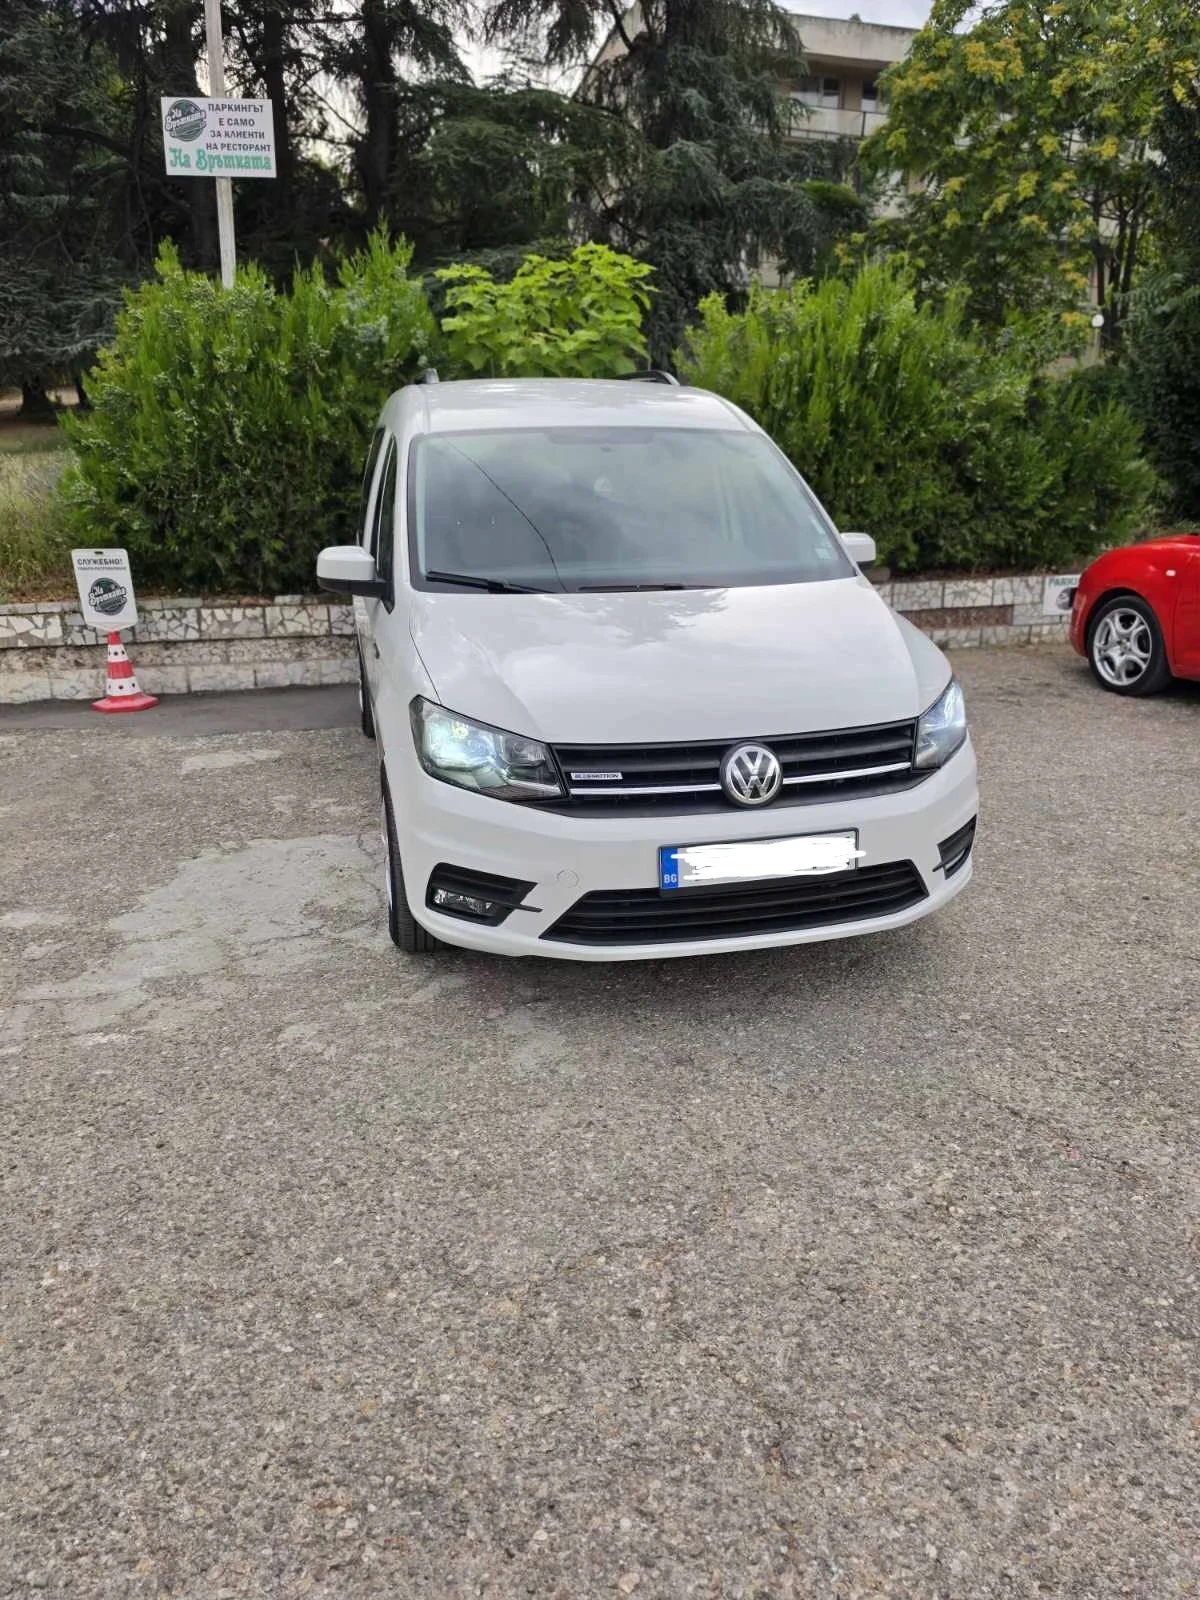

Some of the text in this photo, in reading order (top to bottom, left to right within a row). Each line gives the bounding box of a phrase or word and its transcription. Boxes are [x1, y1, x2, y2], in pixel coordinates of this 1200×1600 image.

[208, 103, 264, 113] ПАРКИНГЪТ
[218, 117, 255, 127] Е САМО
[210, 130, 265, 139] ЗА КЛИЕНТИ
[206, 143, 271, 152] НА РЕСТОРАНТ
[168, 147, 191, 168] На
[663, 873, 678, 883] BG
